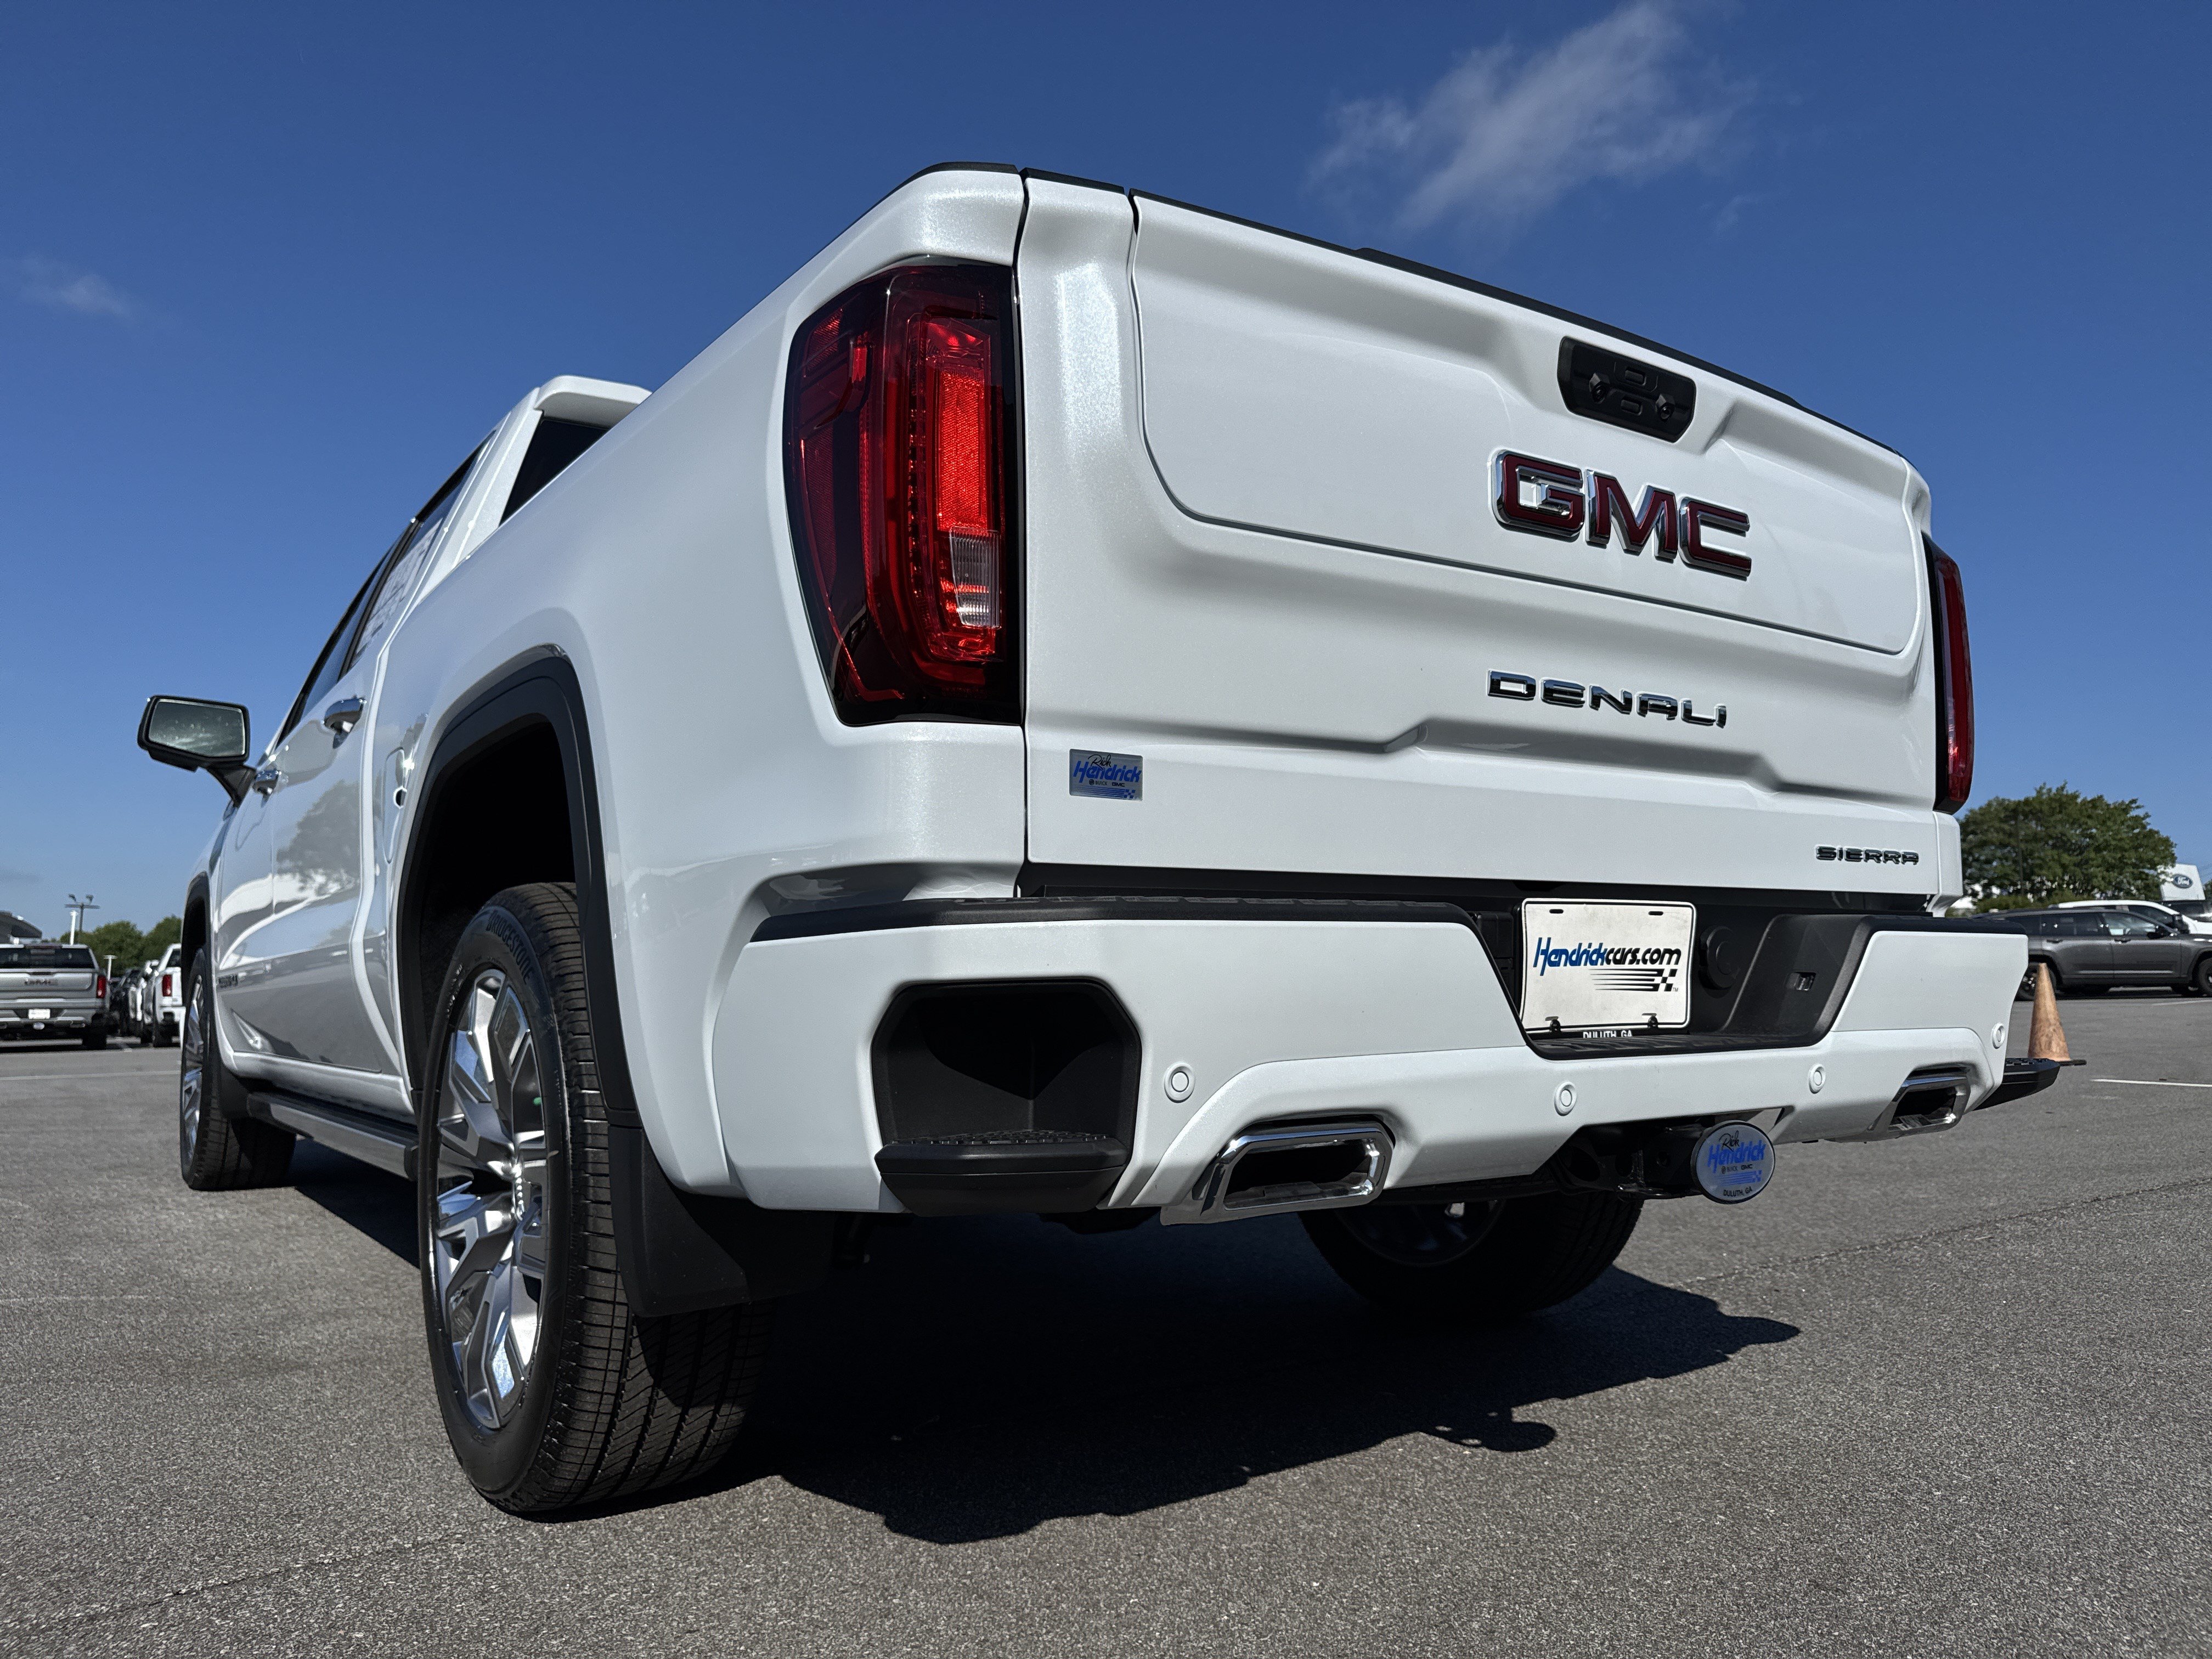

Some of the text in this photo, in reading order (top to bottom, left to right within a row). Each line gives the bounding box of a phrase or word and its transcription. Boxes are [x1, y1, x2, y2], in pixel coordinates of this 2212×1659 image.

[1489, 450, 1751, 580] GMC
[1487, 669, 1727, 728] DENALI
[1073, 761, 1142, 783] Hendrick
[1088, 754, 1111, 772] Rick
[1815, 845, 1919, 865] SIERRA
[486, 910, 532, 984] BRIDGESTONE
[1533, 937, 1682, 977] Hendrickcars.com
[1719, 1130, 1740, 1153] Rick
[1707, 1139, 1766, 1173] Hendrick
[1723, 1188, 1745, 1197] DULUTH,
